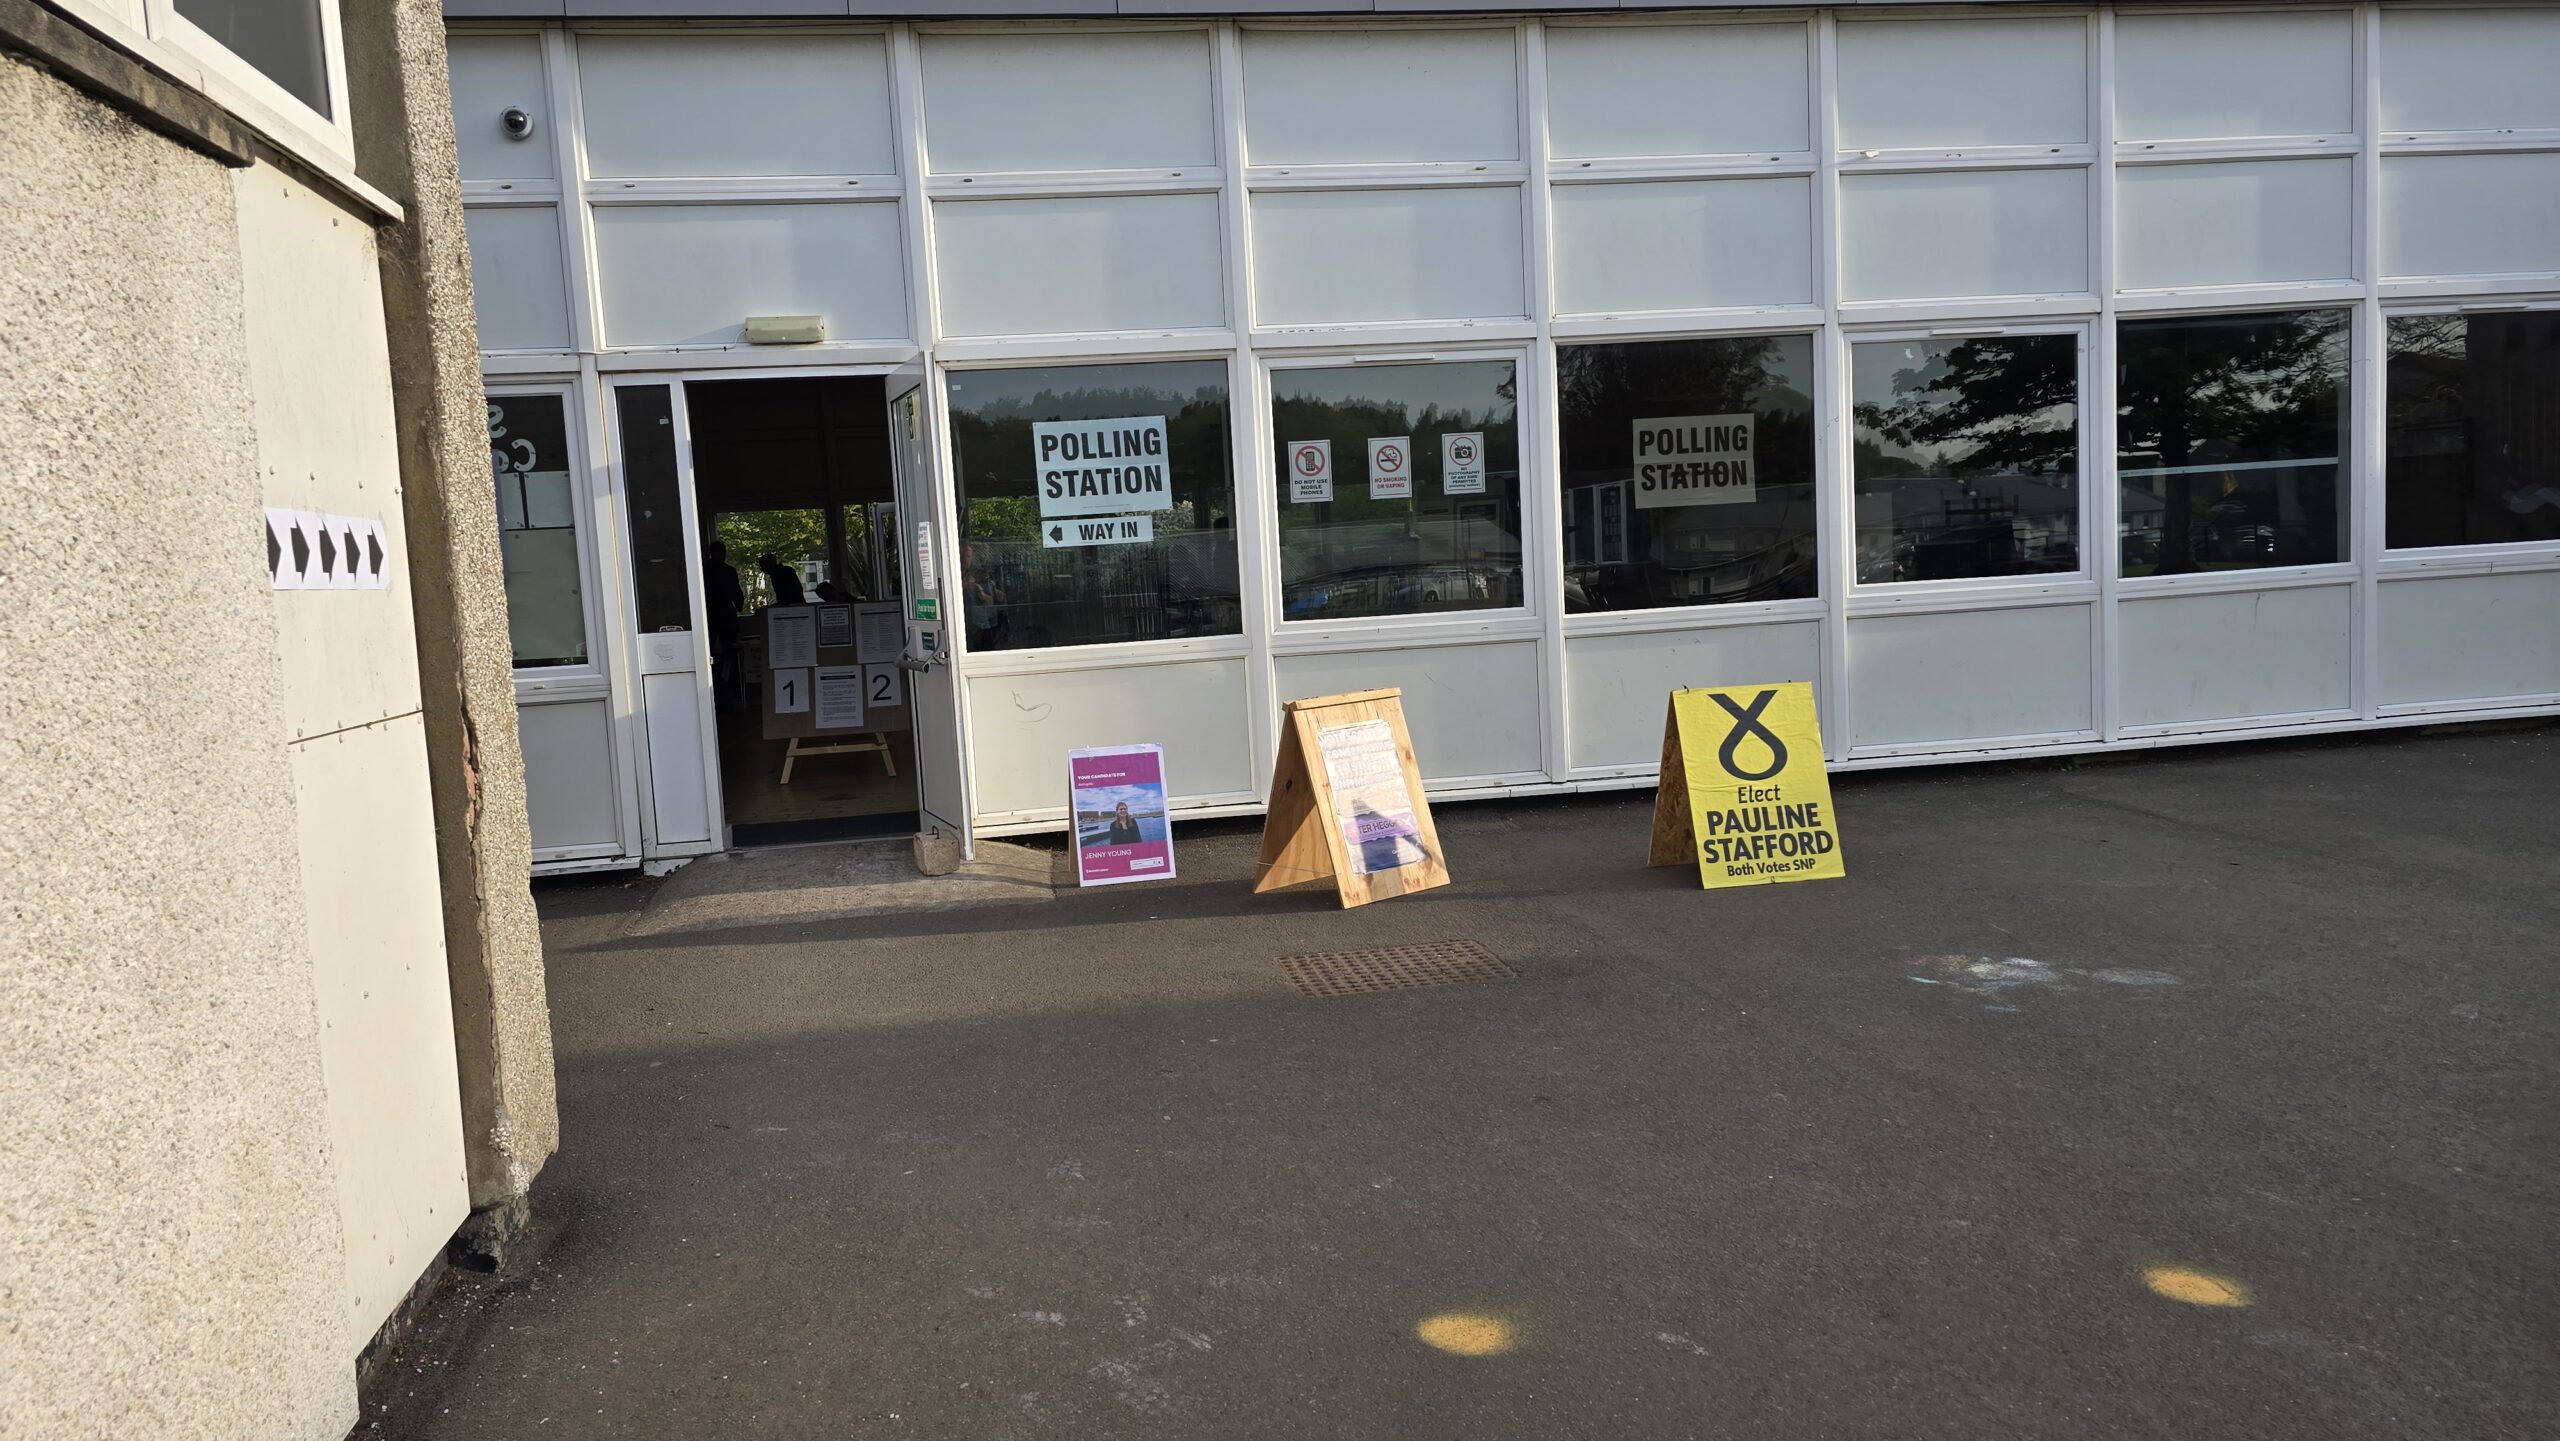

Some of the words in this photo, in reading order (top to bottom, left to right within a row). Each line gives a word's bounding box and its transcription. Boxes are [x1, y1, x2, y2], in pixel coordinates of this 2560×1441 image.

[1041, 428, 1162, 462] POLLING
[1640, 424, 1748, 456] POLLING
[1045, 465, 1163, 499] STATION
[1641, 460, 1748, 492] STATION
[1078, 523, 1115, 541] WAY
[1121, 522, 1138, 538] IN
[782, 680, 794, 706] 1
[872, 674, 892, 701] 2
[1738, 784, 1781, 804] Elect
[1706, 803, 1822, 836] PAULINE
[1086, 852, 1106, 860] JENNY
[1107, 849, 1132, 857] YOUNG
[1704, 830, 1834, 864] STAFFORD
[1727, 862, 1754, 876] Both
[1756, 862, 1791, 874] Votes
[1793, 858, 1816, 871] SNP
